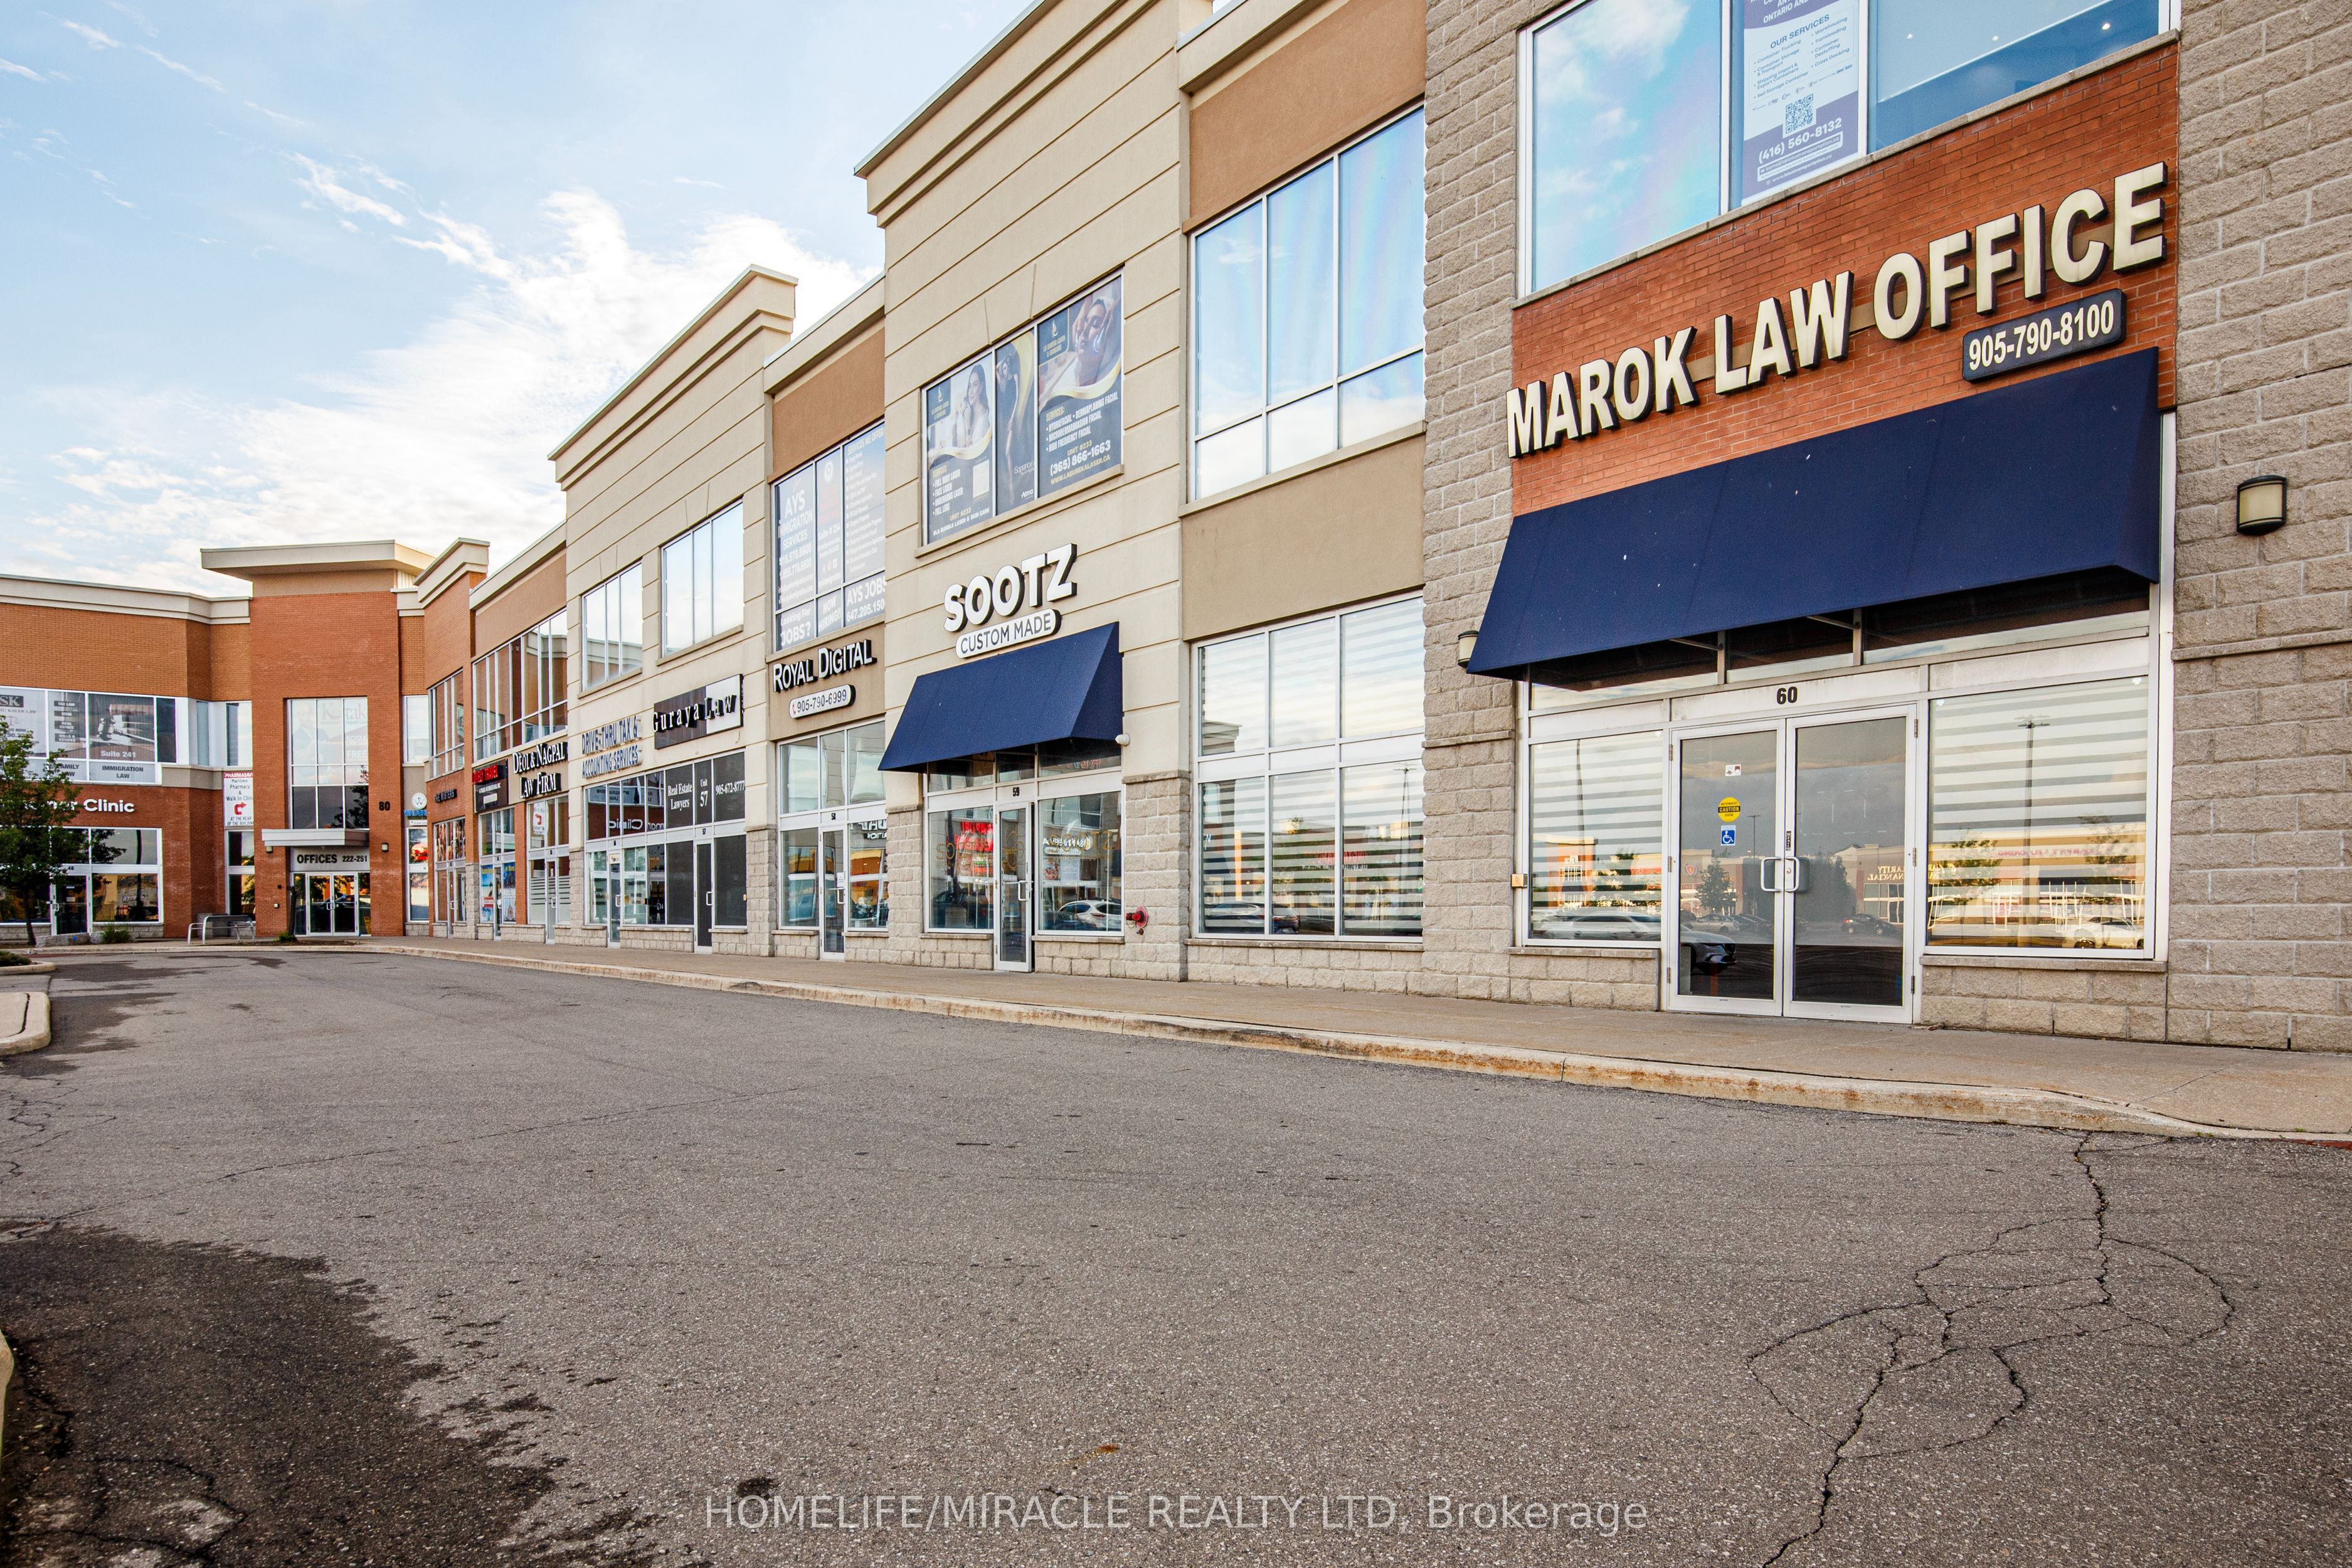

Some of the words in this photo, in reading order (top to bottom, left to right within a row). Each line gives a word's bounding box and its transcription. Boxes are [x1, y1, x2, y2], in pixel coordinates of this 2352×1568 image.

[1763, 4, 1793, 23] ONTARIO
[1770, 35, 1788, 49] OUR
[1789, 14, 1830, 40] SERVICES
[1815, 38, 1840, 52] Container
[1757, 50, 1781, 63] Container
[1757, 58, 1781, 72] Container
[1759, 142, 1785, 164] (416)
[1788, 117, 1842, 149] 560-8132
[1506, 326, 1698, 458] MAROK
[1714, 270, 1854, 395] LAW
[1873, 162, 2167, 341] OFFICE
[1968, 299, 2114, 371] 905-790-8100
[1050, 457, 1071, 476] (365)
[1071, 439, 1111, 467] 866-1663
[1067, 446, 1079, 456] UNIT
[784, 489, 806, 520] AYS
[783, 529, 808, 550] SERVICES
[847, 586, 862, 607] AYS
[943, 543, 1076, 632] SOOTZ
[823, 595, 837, 614] NOW
[847, 598, 885, 622] 647.205.150
[780, 611, 801, 627] Looking
[802, 608, 811, 618] For
[818, 607, 842, 633] HIRING!!
[780, 621, 811, 647] JOBS?
[960, 624, 1010, 654] CUSTOM
[1014, 612, 1052, 641] MADE
[773, 659, 814, 692] ROYAL
[818, 639, 872, 679] DIGITAL
[797, 689, 847, 713] 905-790-6999
[1776, 686, 1798, 704] 60
[322, 702, 367, 721] Ktak
[652, 703, 699, 733] Guraya
[704, 694, 734, 720] Law
[582, 722, 617, 755] DRIVE-THRU
[619, 717, 631, 743] TAX
[633, 715, 638, 739] &
[100, 750, 120, 758] Suite
[347, 750, 367, 758] FREE
[530, 751, 536, 769] &
[536, 741, 565, 767] NAGPAL
[582, 753, 612, 779] ACCOUNTING
[613, 744, 638, 770] SERVICES
[520, 777, 534, 798] LAW
[536, 771, 557, 795] FIRM
[668, 784, 678, 797] Real
[678, 782, 692, 795] Estate
[700, 778, 708, 787] Unit
[1012, 787, 1020, 797] 59
[83, 798, 135, 813] Clinic
[379, 801, 391, 811] 80
[670, 798, 690, 811] Lawyers
[700, 790, 708, 807] 57
[297, 854, 337, 864] OFFICES
